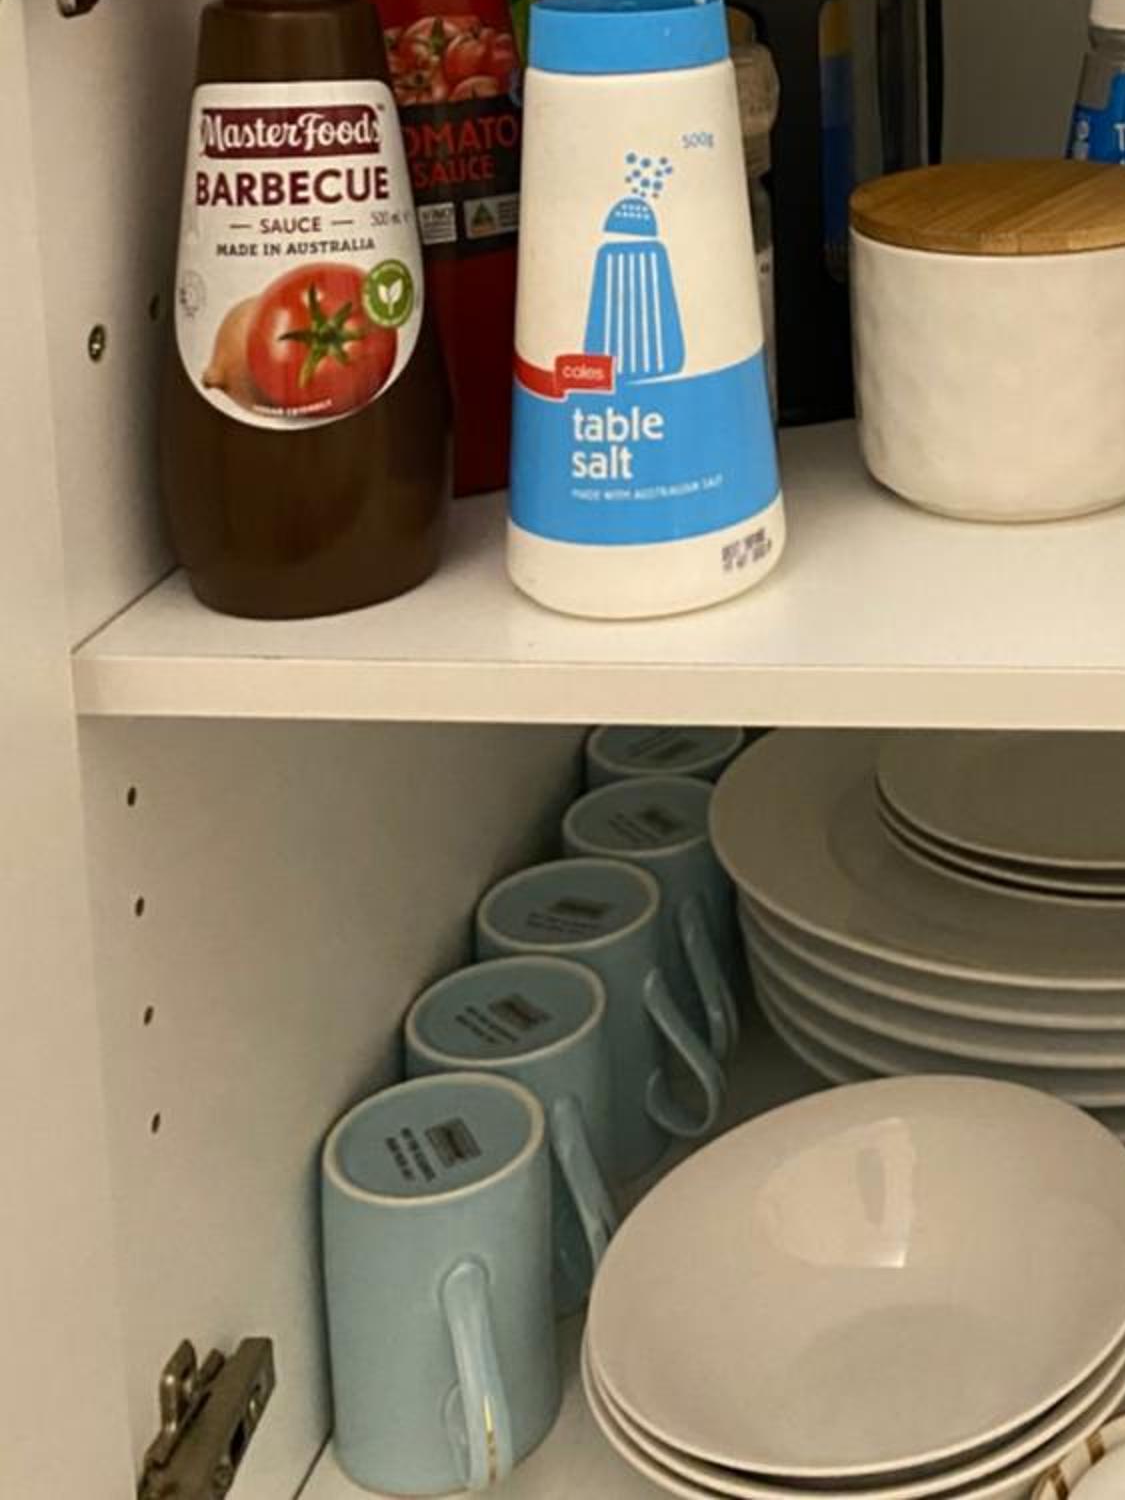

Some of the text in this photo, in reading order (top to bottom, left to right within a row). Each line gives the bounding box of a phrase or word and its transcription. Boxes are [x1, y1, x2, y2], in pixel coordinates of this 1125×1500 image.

[404, 114, 518, 154] OMATO
[195, 165, 390, 206] BARBECUE
[413, 154, 497, 188] SAUCE
[260, 216, 322, 234] SAUCE
[216, 237, 376, 257] MADE IN AUSTRALIA
[562, 363, 604, 381] coles
[572, 406, 665, 442] table
[571, 444, 634, 480] salt
